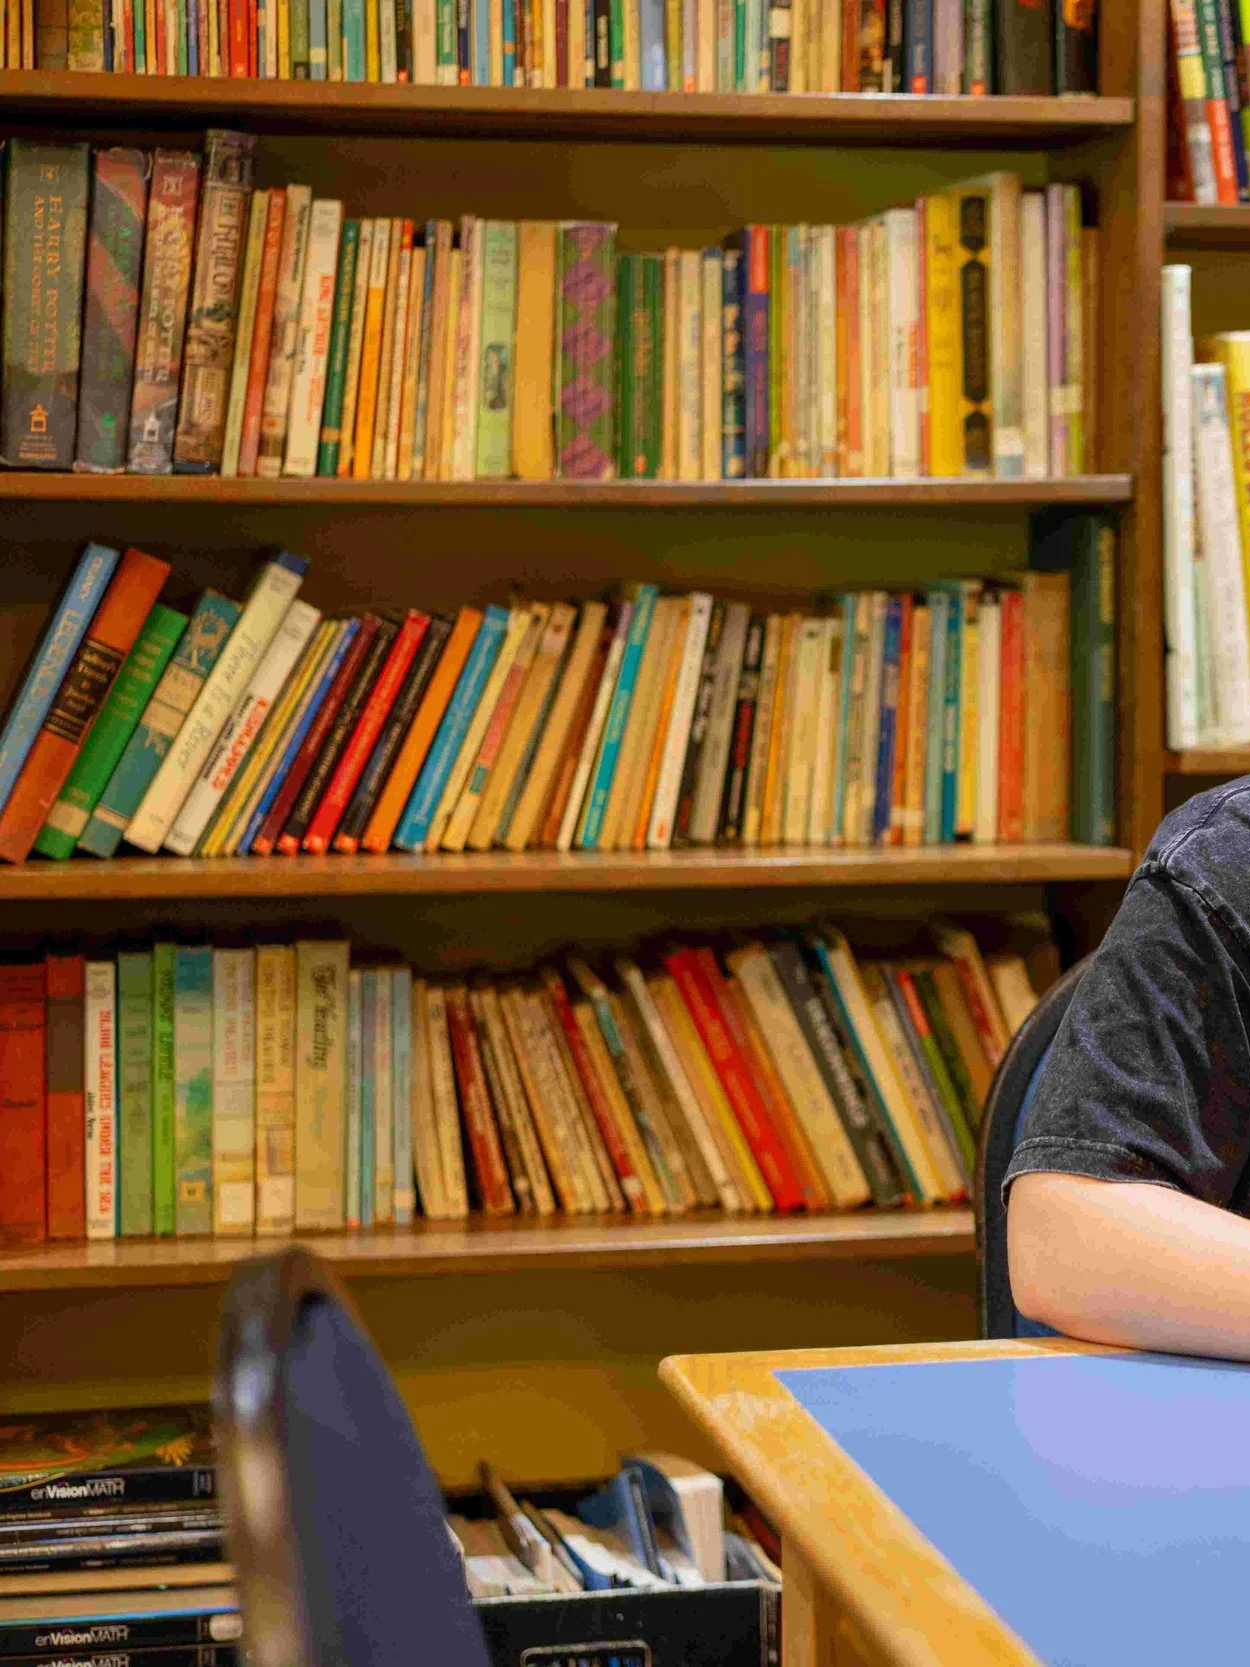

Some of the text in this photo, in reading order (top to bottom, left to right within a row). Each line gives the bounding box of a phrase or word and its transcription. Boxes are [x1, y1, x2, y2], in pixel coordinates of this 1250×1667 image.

[41, 195, 63, 375] HARRY POTTER
[30, 1477, 125, 1500] enVisionMATH
[34, 1624, 129, 1647] enVisionMATH
